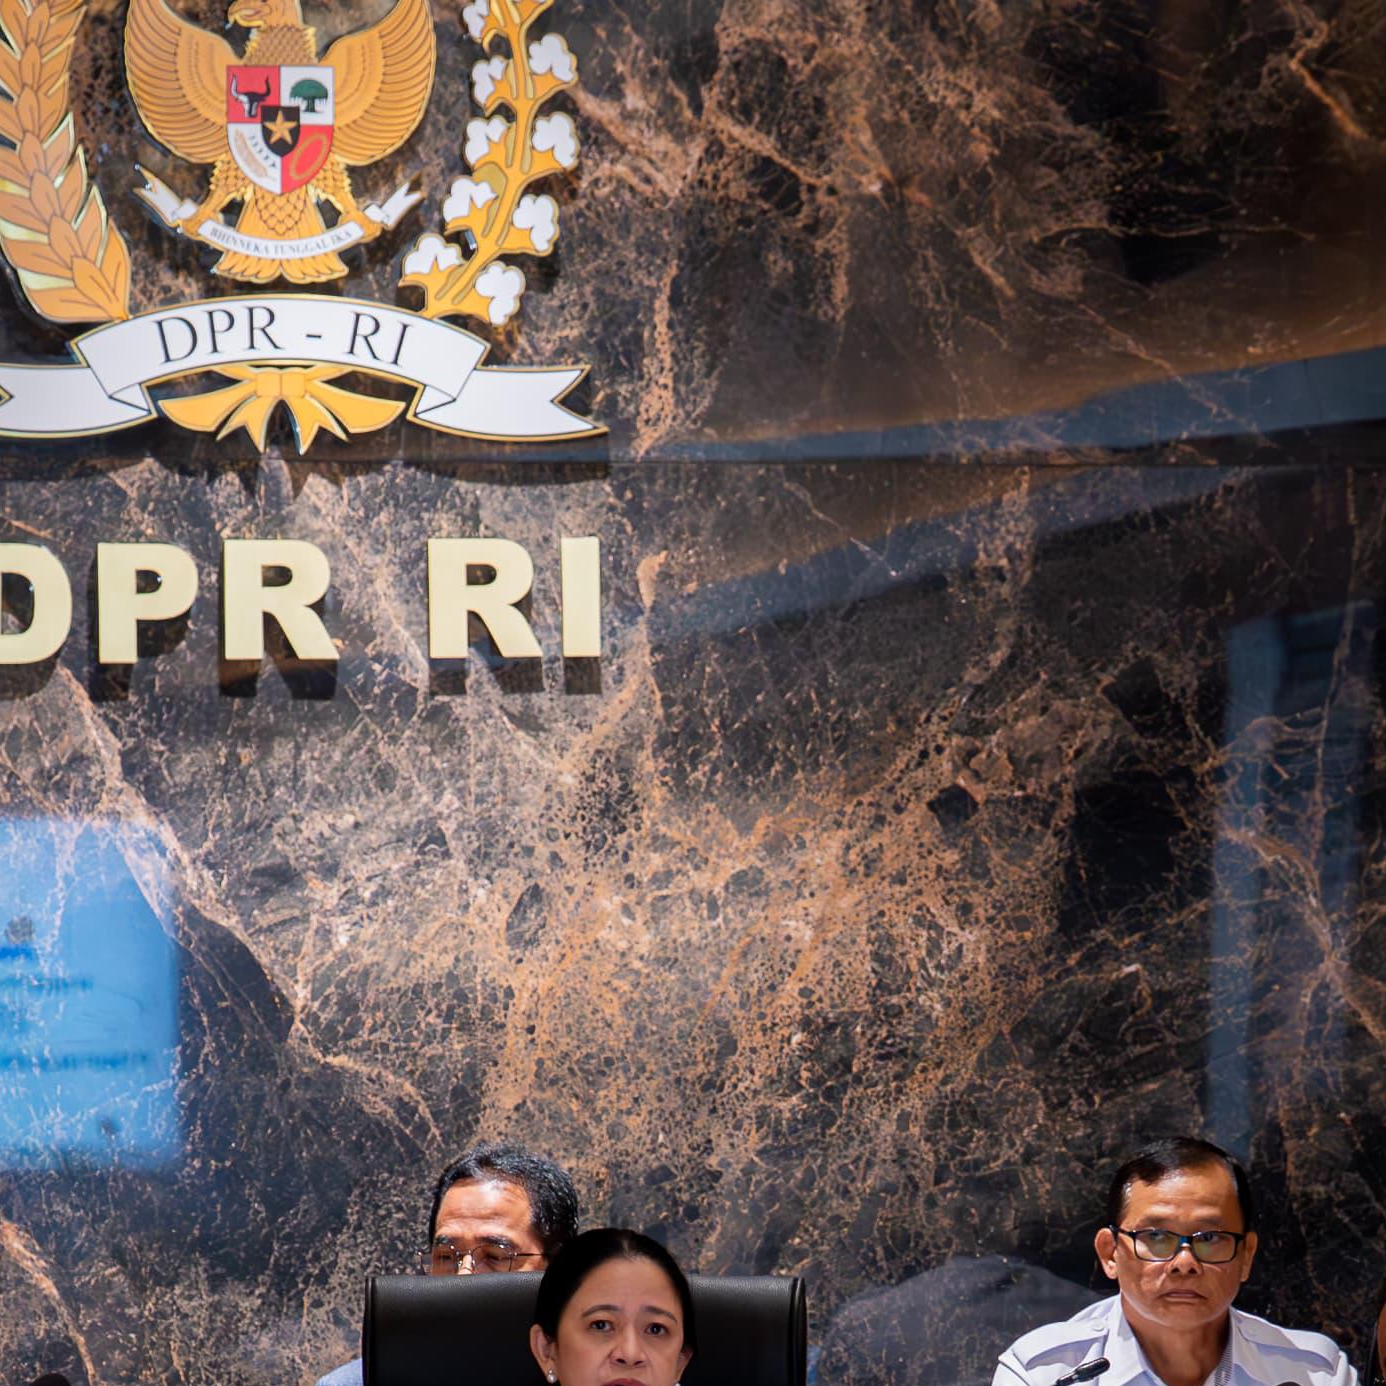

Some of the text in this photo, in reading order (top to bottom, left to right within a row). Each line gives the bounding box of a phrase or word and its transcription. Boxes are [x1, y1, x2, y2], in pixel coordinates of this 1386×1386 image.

[153, 305, 285, 364] DPR
[346, 310, 413, 367] RI
[427, 536, 602, 660] RI
